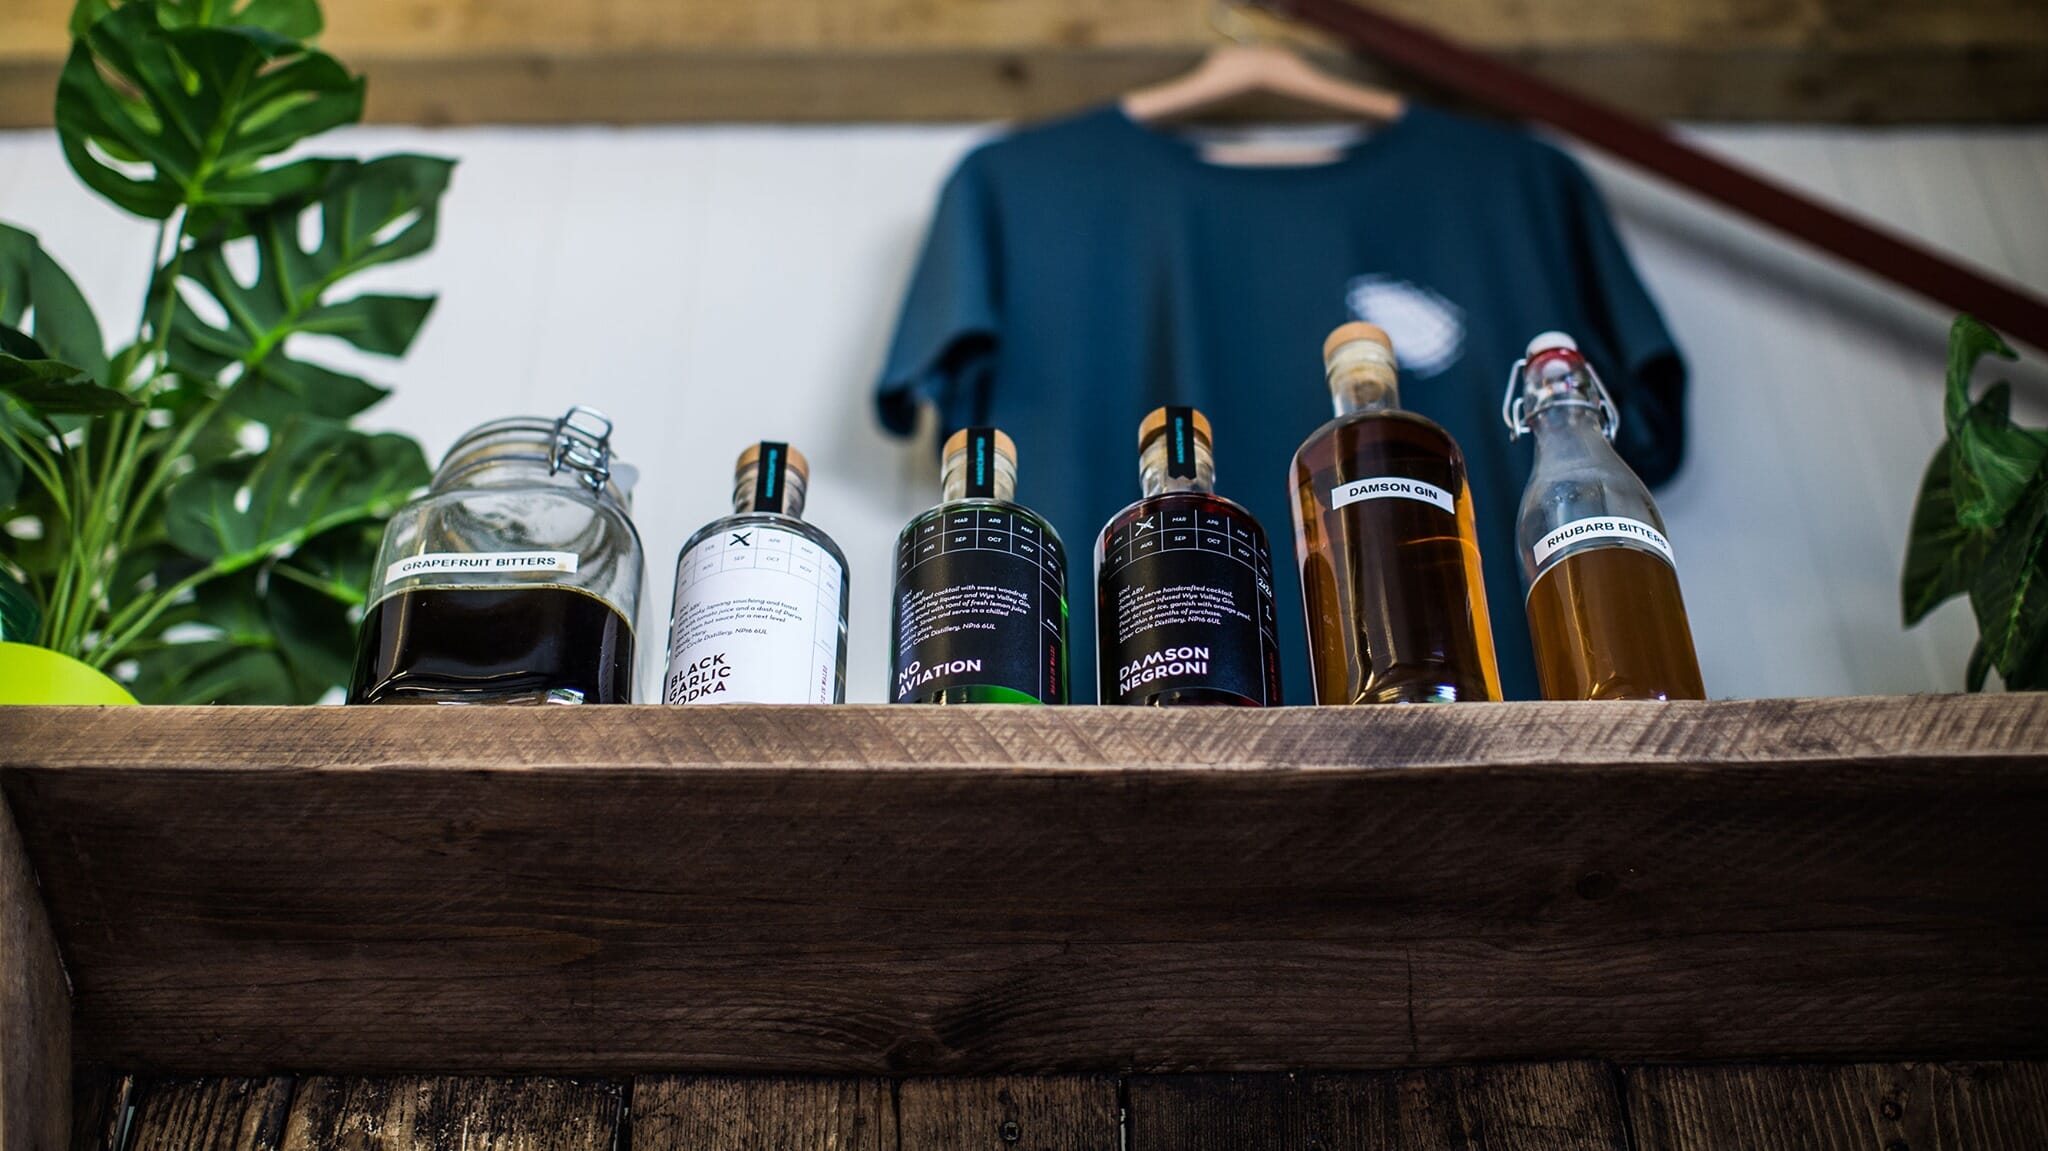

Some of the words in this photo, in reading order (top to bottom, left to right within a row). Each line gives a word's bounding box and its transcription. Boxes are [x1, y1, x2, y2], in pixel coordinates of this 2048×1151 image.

[1349, 482, 1411, 497] DAMSON
[1414, 485, 1438, 500] GIN
[1547, 522, 1615, 549] RHUBARB
[1020, 544, 1034, 553] NOV
[402, 557, 492, 572] GRAPEFRUIT
[495, 556, 557, 567] BITTERS
[934, 585, 960, 597] cocktail
[979, 592, 995, 600] Wye
[996, 593, 1018, 604] Valley
[961, 599, 970, 607] of
[1131, 599, 1155, 612] damson
[1182, 592, 1198, 600] Wye
[1200, 593, 1221, 603] Valley
[1170, 600, 1196, 609] garnish
[937, 609, 951, 618] and
[1154, 609, 1179, 619] months
[1180, 607, 1189, 616] of
[1134, 623, 1154, 634] Circle
[1206, 617, 1222, 625] 6UL
[671, 653, 725, 689] BLACK
[1119, 646, 1209, 681] DAMSON
[898, 659, 982, 700] AVIATION
[899, 660, 921, 685] NO
[1119, 661, 1208, 696] NEGRONI
[669, 666, 731, 702] GARLIC
